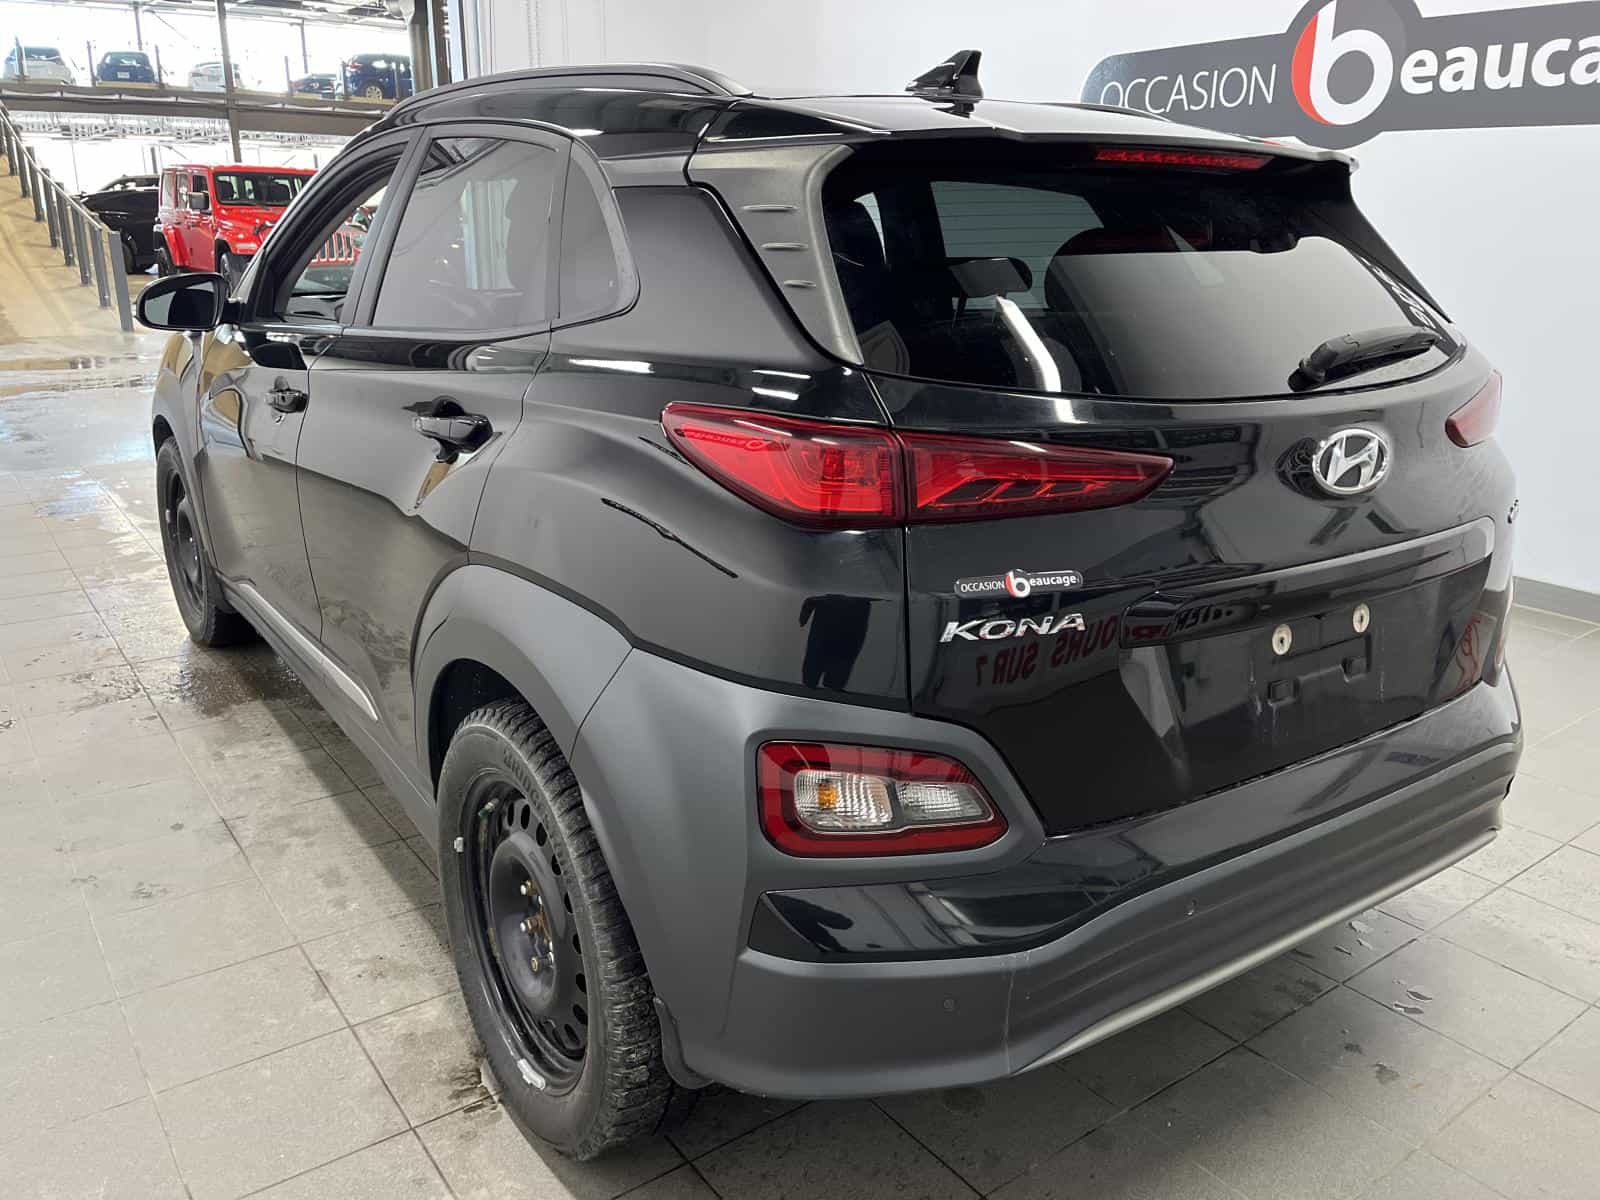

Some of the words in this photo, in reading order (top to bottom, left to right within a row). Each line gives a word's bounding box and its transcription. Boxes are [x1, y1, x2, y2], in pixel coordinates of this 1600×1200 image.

[1100, 63, 1277, 114] OCCASION
[960, 580, 1005, 593] OCCASION
[1007, 569, 1077, 598] beaucage
[939, 612, 1087, 643] KONA
